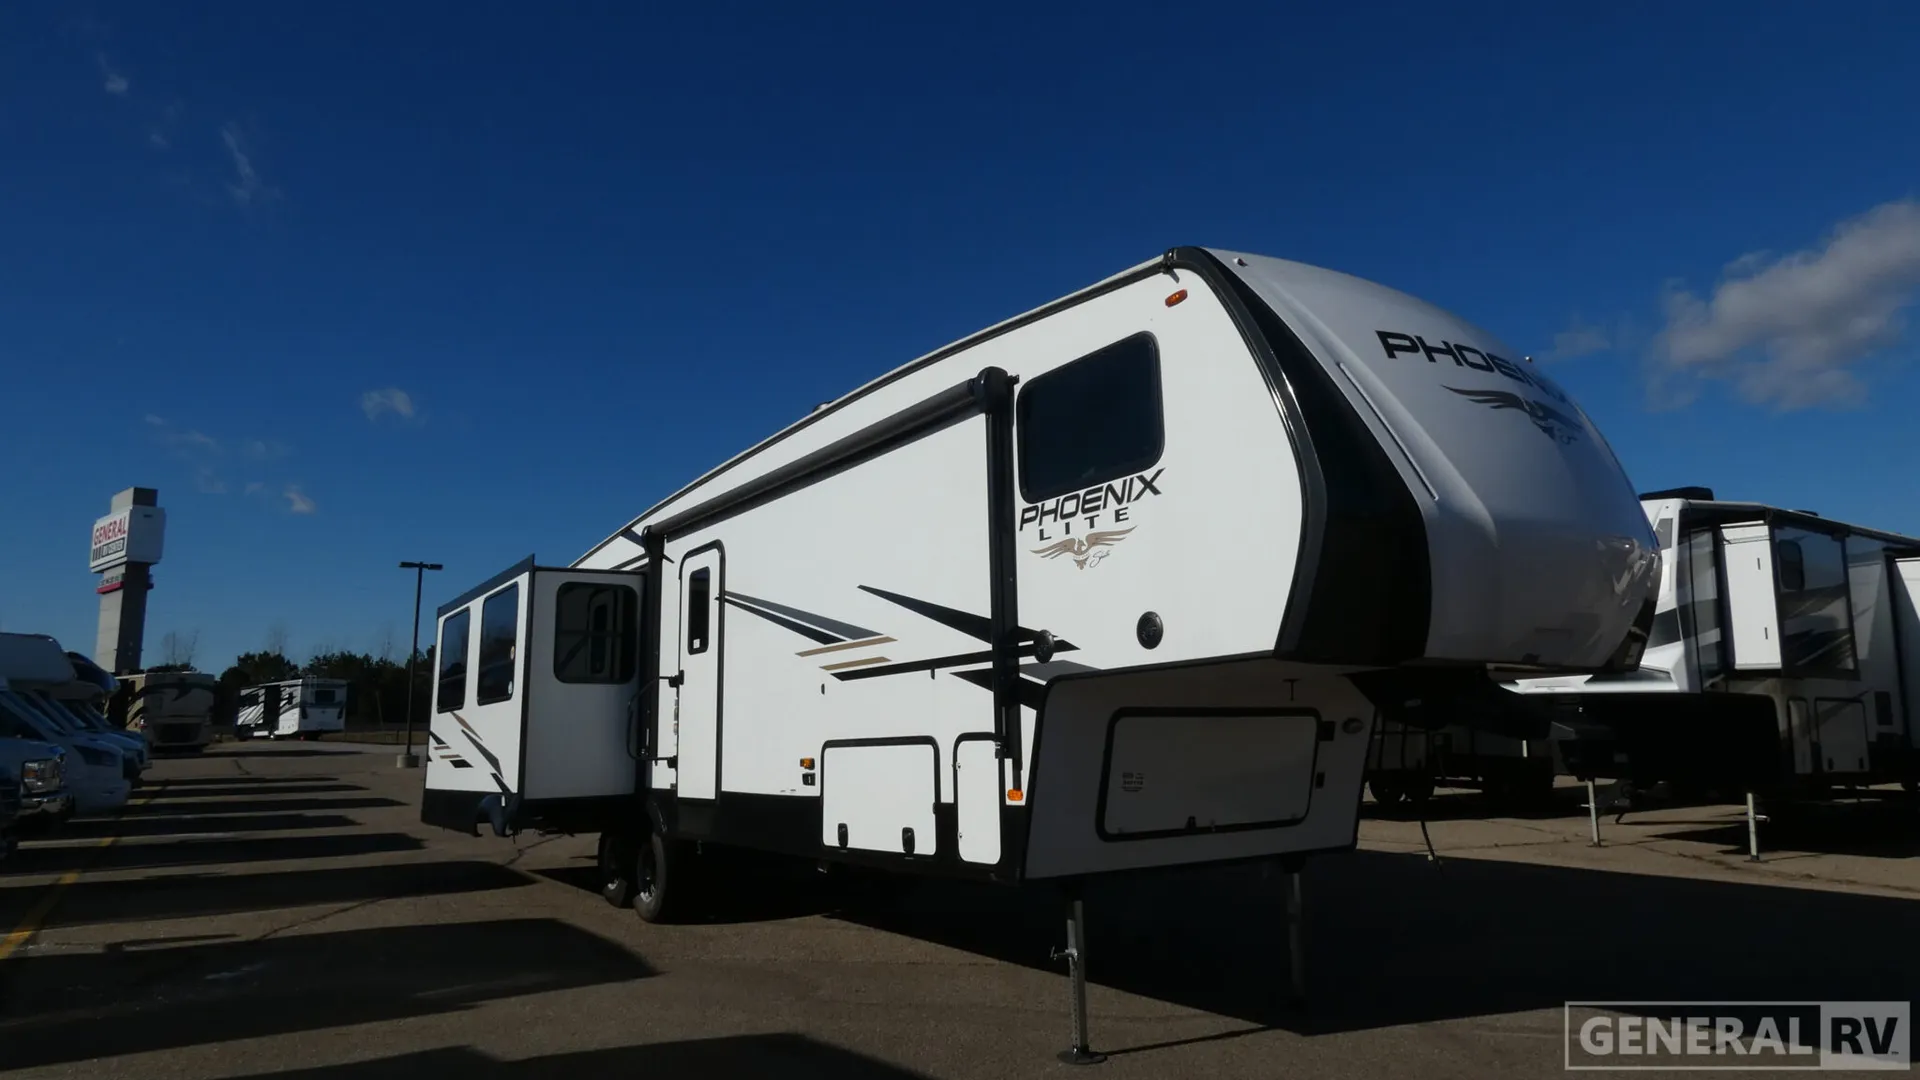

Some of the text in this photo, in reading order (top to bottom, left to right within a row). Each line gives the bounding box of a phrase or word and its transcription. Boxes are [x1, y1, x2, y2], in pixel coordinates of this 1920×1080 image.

[1019, 467, 1166, 532] PHOENIX
[93, 516, 127, 546] GENERAL
[1039, 506, 1129, 541] LITE
